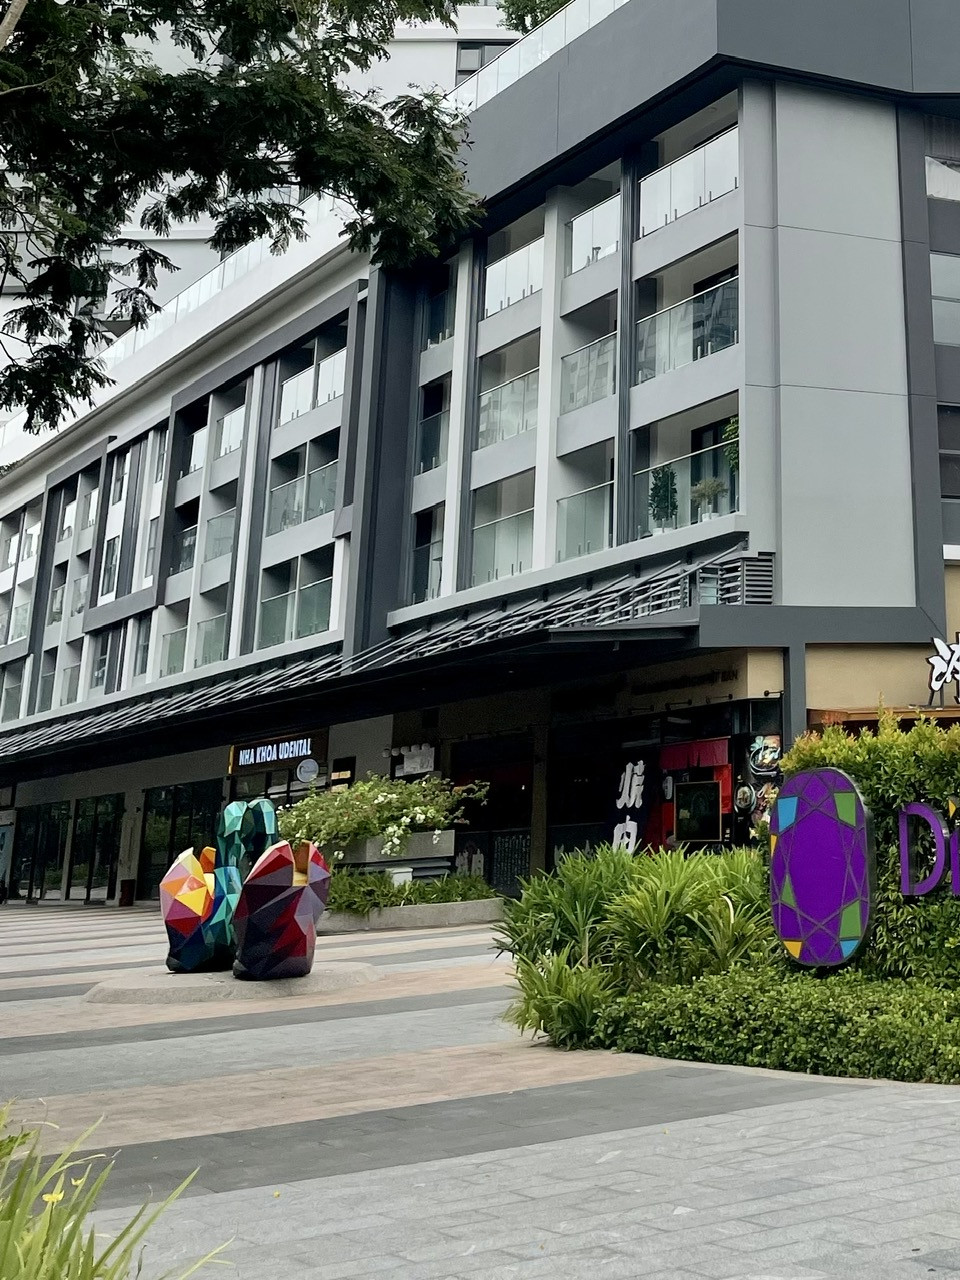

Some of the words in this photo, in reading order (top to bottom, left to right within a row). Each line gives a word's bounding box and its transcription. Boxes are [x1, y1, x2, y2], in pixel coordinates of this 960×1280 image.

[239, 748, 255, 766] NHA
[255, 744, 277, 764] KHOA
[278, 738, 312, 759] UDENTAL
